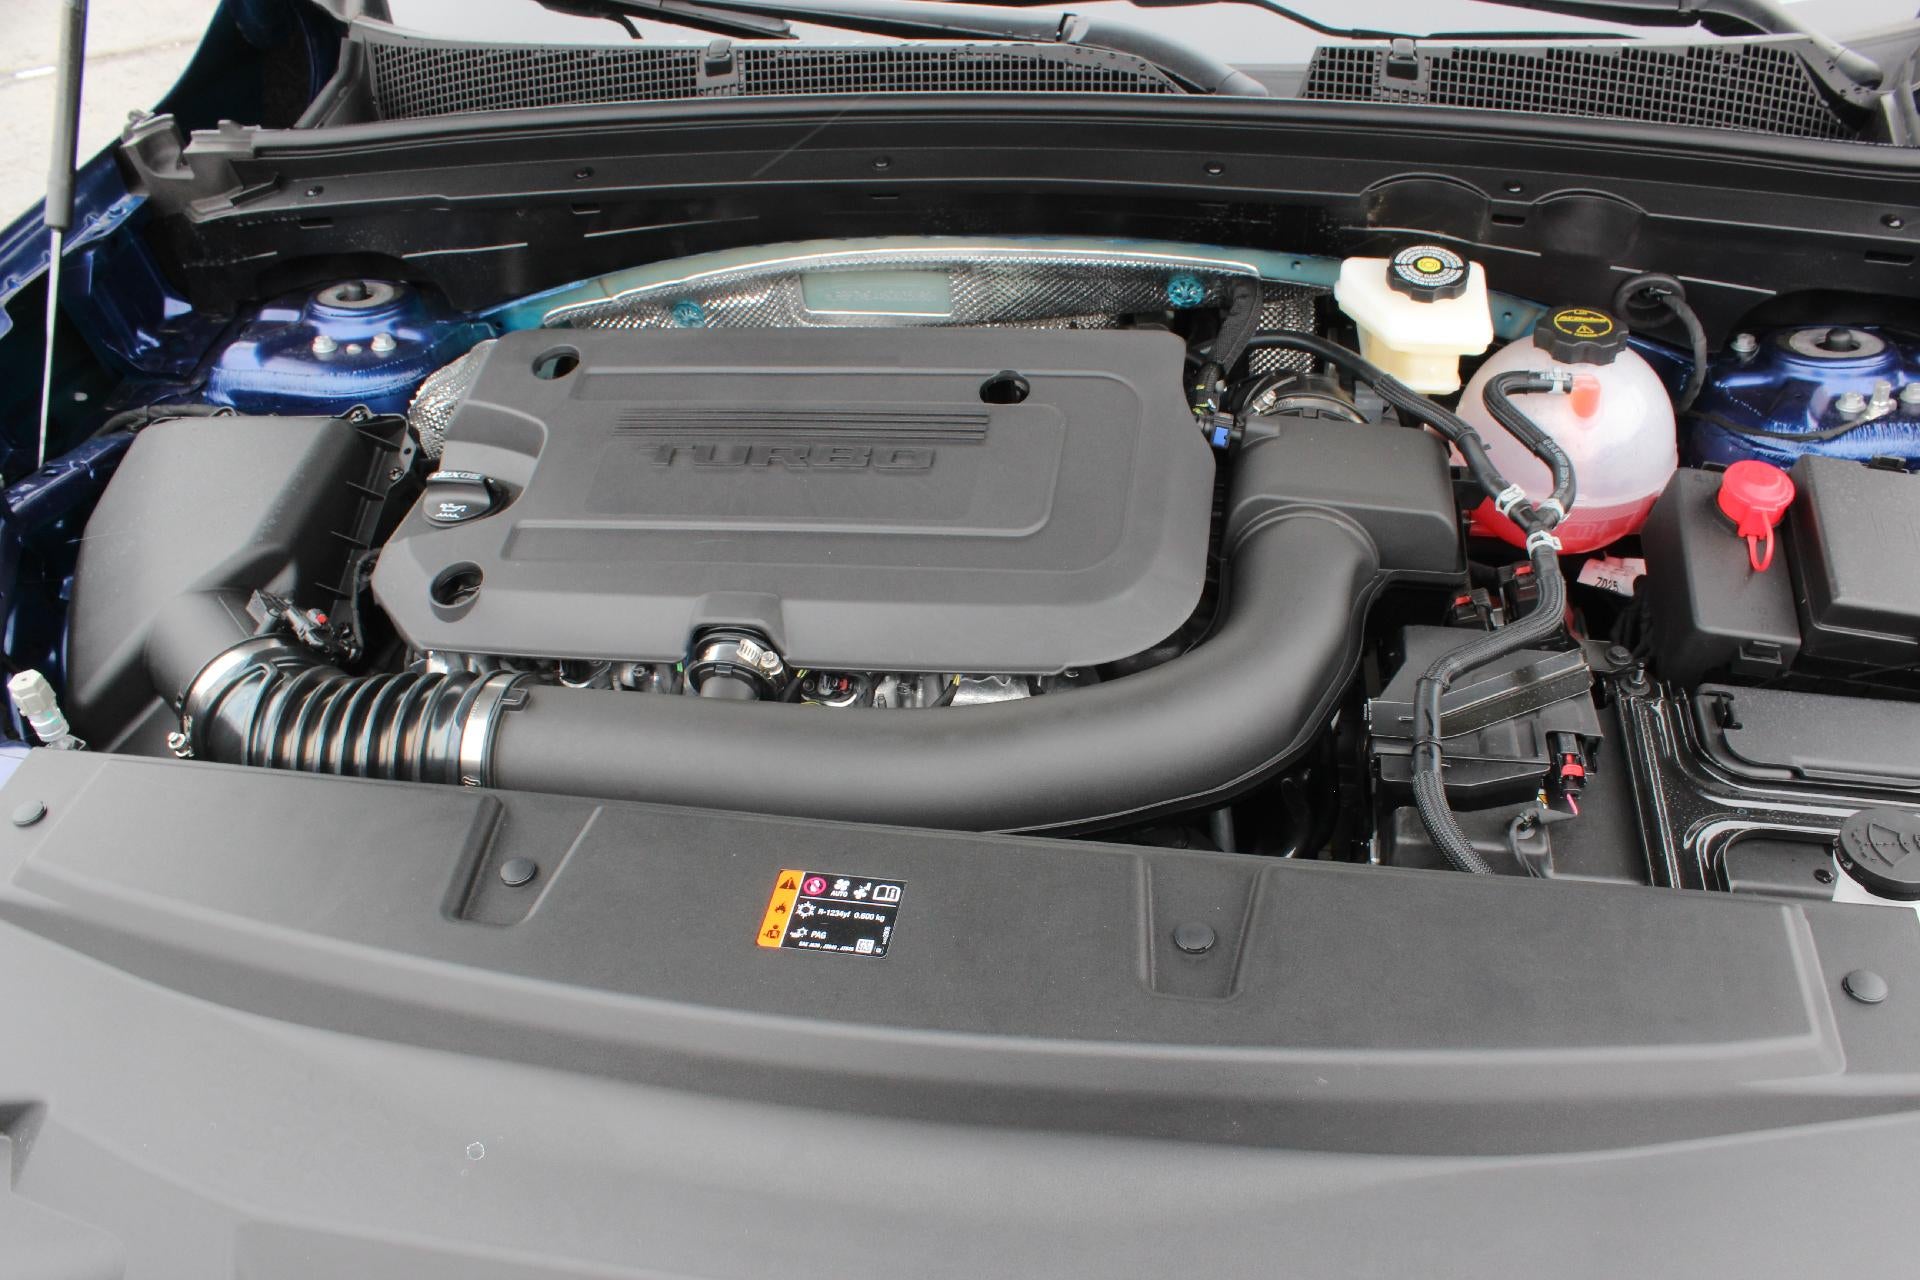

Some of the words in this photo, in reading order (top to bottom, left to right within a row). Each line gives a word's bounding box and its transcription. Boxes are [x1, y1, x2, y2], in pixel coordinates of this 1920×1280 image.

[641, 446, 936, 471] TURBO
[830, 890, 848, 898] AUTO
[818, 908, 850, 918] R-1234yf
[875, 914, 885, 922] kg
[810, 931, 826, 940] PAG
